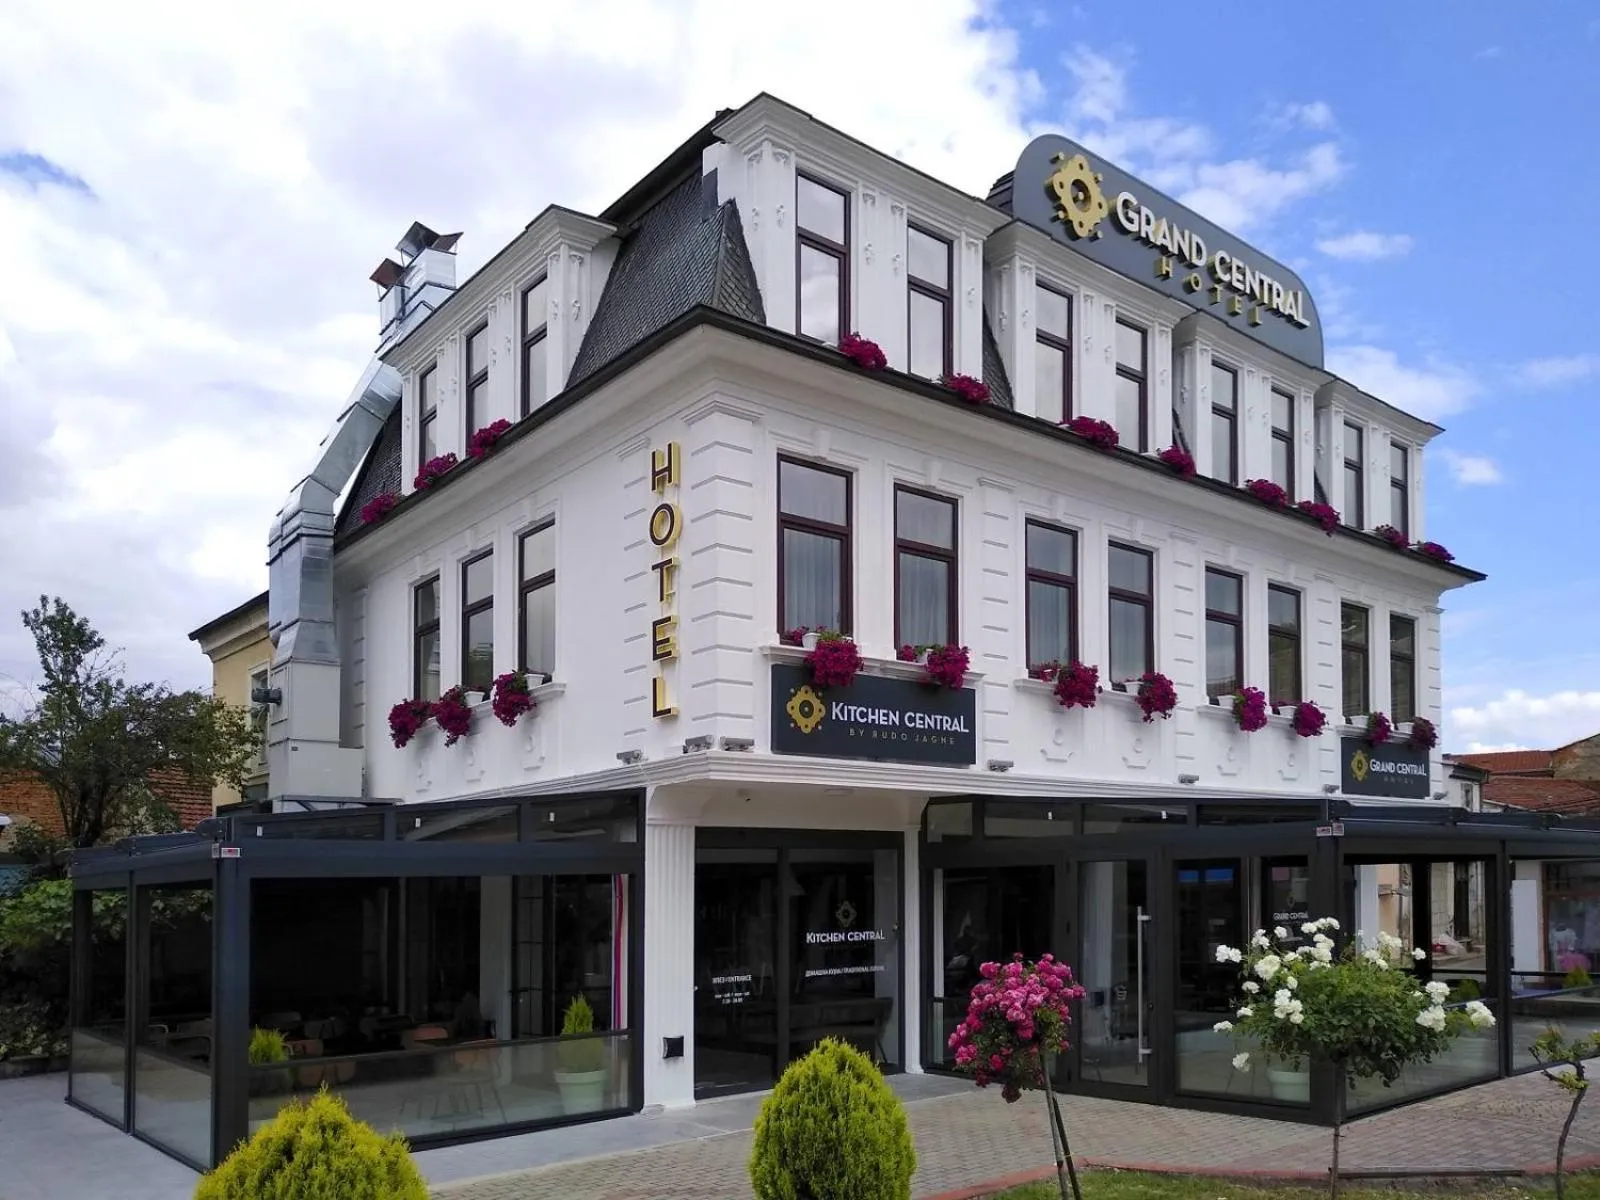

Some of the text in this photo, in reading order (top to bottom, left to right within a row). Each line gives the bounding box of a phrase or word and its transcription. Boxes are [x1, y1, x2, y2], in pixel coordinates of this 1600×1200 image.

[1116, 191, 1310, 329] GRAND CENTRAL
[1158, 256, 1262, 326] HOTEL
[650, 441, 681, 719] HOTEL
[831, 701, 969, 733] KITCHEN CENTRAL
[849, 728, 865, 737] BY
[1369, 758, 1427, 777] GRAND CENTRAL
[806, 929, 886, 944] KITCHEN CENTRAL
